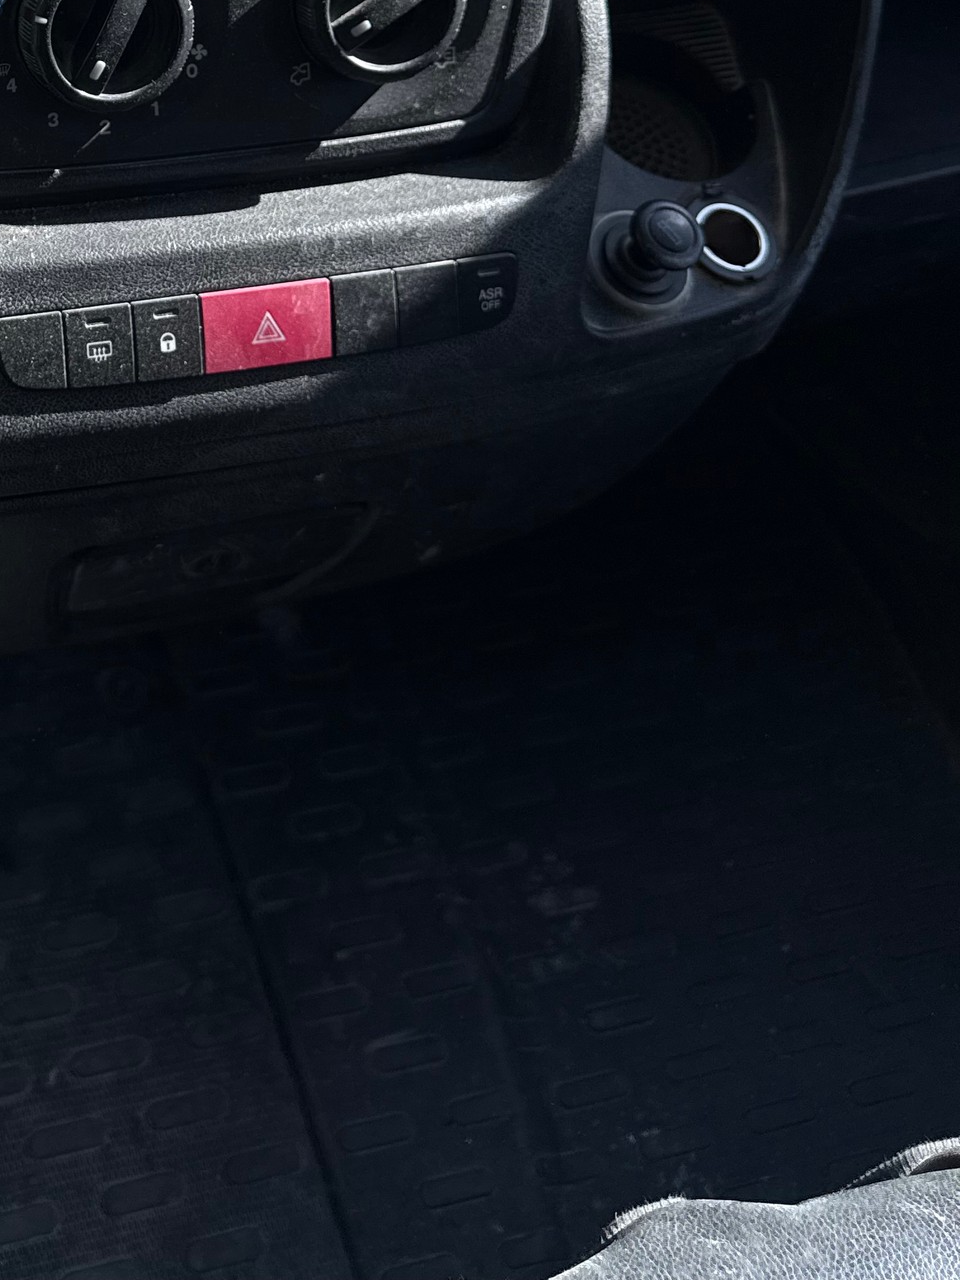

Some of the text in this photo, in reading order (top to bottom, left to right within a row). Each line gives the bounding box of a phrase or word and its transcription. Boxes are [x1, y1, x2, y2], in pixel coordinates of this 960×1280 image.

[6, 77, 17, 94] 4
[151, 101, 160, 117] 1
[47, 112, 59, 128] 3
[99, 120, 111, 136] 2
[478, 287, 503, 300] ASR
[481, 299, 501, 311] OFF
